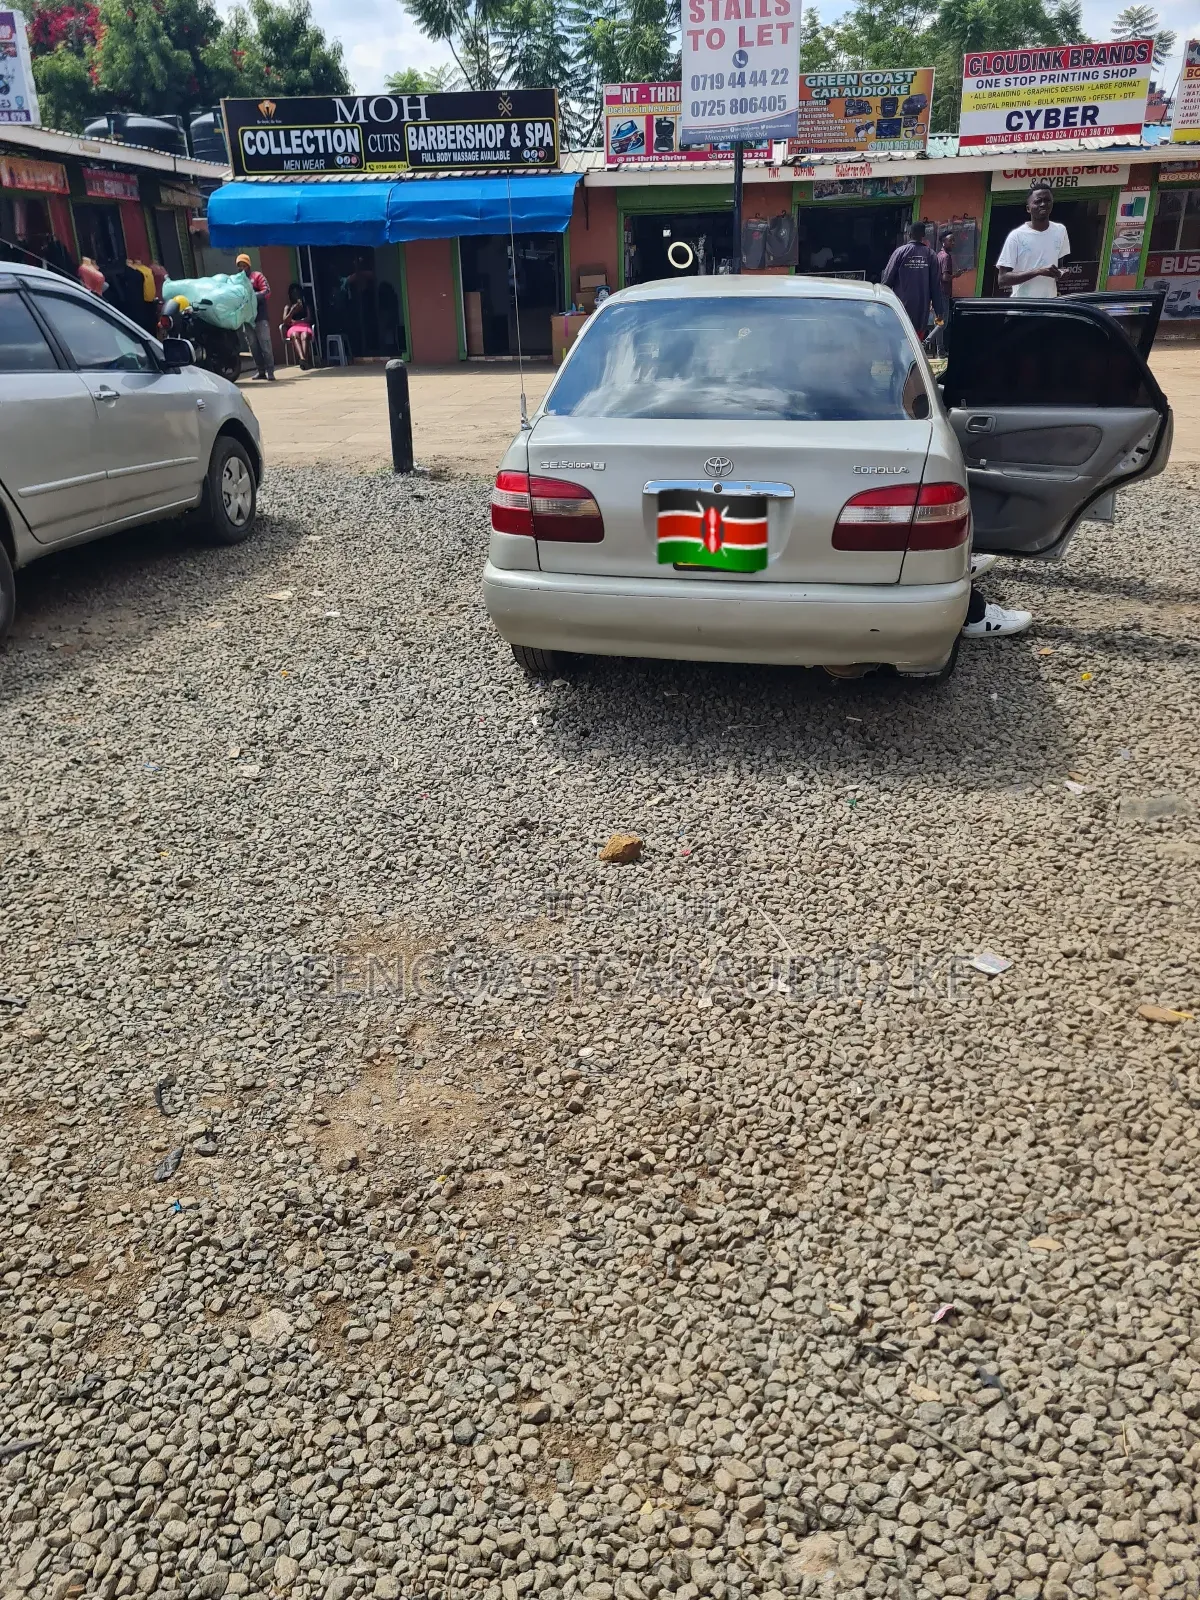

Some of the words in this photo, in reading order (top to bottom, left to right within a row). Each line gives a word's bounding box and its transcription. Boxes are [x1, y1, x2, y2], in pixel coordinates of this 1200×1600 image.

[689, 0, 791, 23] STALLS
[687, 28, 725, 51] TO
[738, 22, 794, 48] LET
[969, 51, 1065, 76] CLOUDINK
[1069, 43, 1149, 68] BRANDS
[691, 73, 724, 91] 0719
[728, 71, 746, 88] 44
[749, 70, 767, 87] 44
[771, 68, 789, 85] 22
[805, 74, 858, 87] GREEN
[861, 71, 915, 84] COAST
[976, 79, 1000, 89] ONE
[1004, 75, 1036, 87] STOP
[1040, 70, 1099, 84] PRINTING
[1102, 68, 1137, 79] SHOP
[622, 88, 638, 103] NT
[649, 86, 680, 102] THRI
[811, 87, 840, 98] CAR
[890, 84, 909, 95] KE
[988, 90, 1021, 98] BRANDING
[1027, 87, 1058, 96] GRAPHICS
[1061, 85, 1084, 93] DESIGN
[1091, 83, 1112, 91] LARGE
[1114, 81, 1141, 89] FORMAT
[1057, 95, 1086, 103] PRINTING
[1092, 93, 1116, 101] OFFSET
[332, 95, 430, 124] MOH
[608, 105, 638, 114] Dealers
[640, 104, 647, 113] in
[648, 104, 665, 113] New
[667, 103, 681, 112] and
[691, 100, 725, 117] 0725
[730, 95, 786, 115] 806405
[1005, 105, 1099, 132] CYBER
[243, 128, 360, 155] COLLECTION
[368, 133, 400, 153] CUTS
[407, 123, 505, 151] BARBERSHOP
[510, 123, 521, 147] &
[525, 122, 553, 147] SPA
[986, 134, 1012, 144] CONTACT
[1013, 133, 1023, 142] US:
[1103, 126, 1115, 135] 709
[284, 160, 300, 170] MEN
[302, 159, 325, 170] WEAR
[421, 152, 436, 162] FULL
[437, 151, 451, 162] BODY
[452, 151, 479, 162] MASSAGE
[480, 150, 510, 161] AVAILABLE
[1039, 176, 1078, 188] CYBER
[1159, 171, 1200, 182] BOOK
[853, 465, 910, 474] COROLLA
